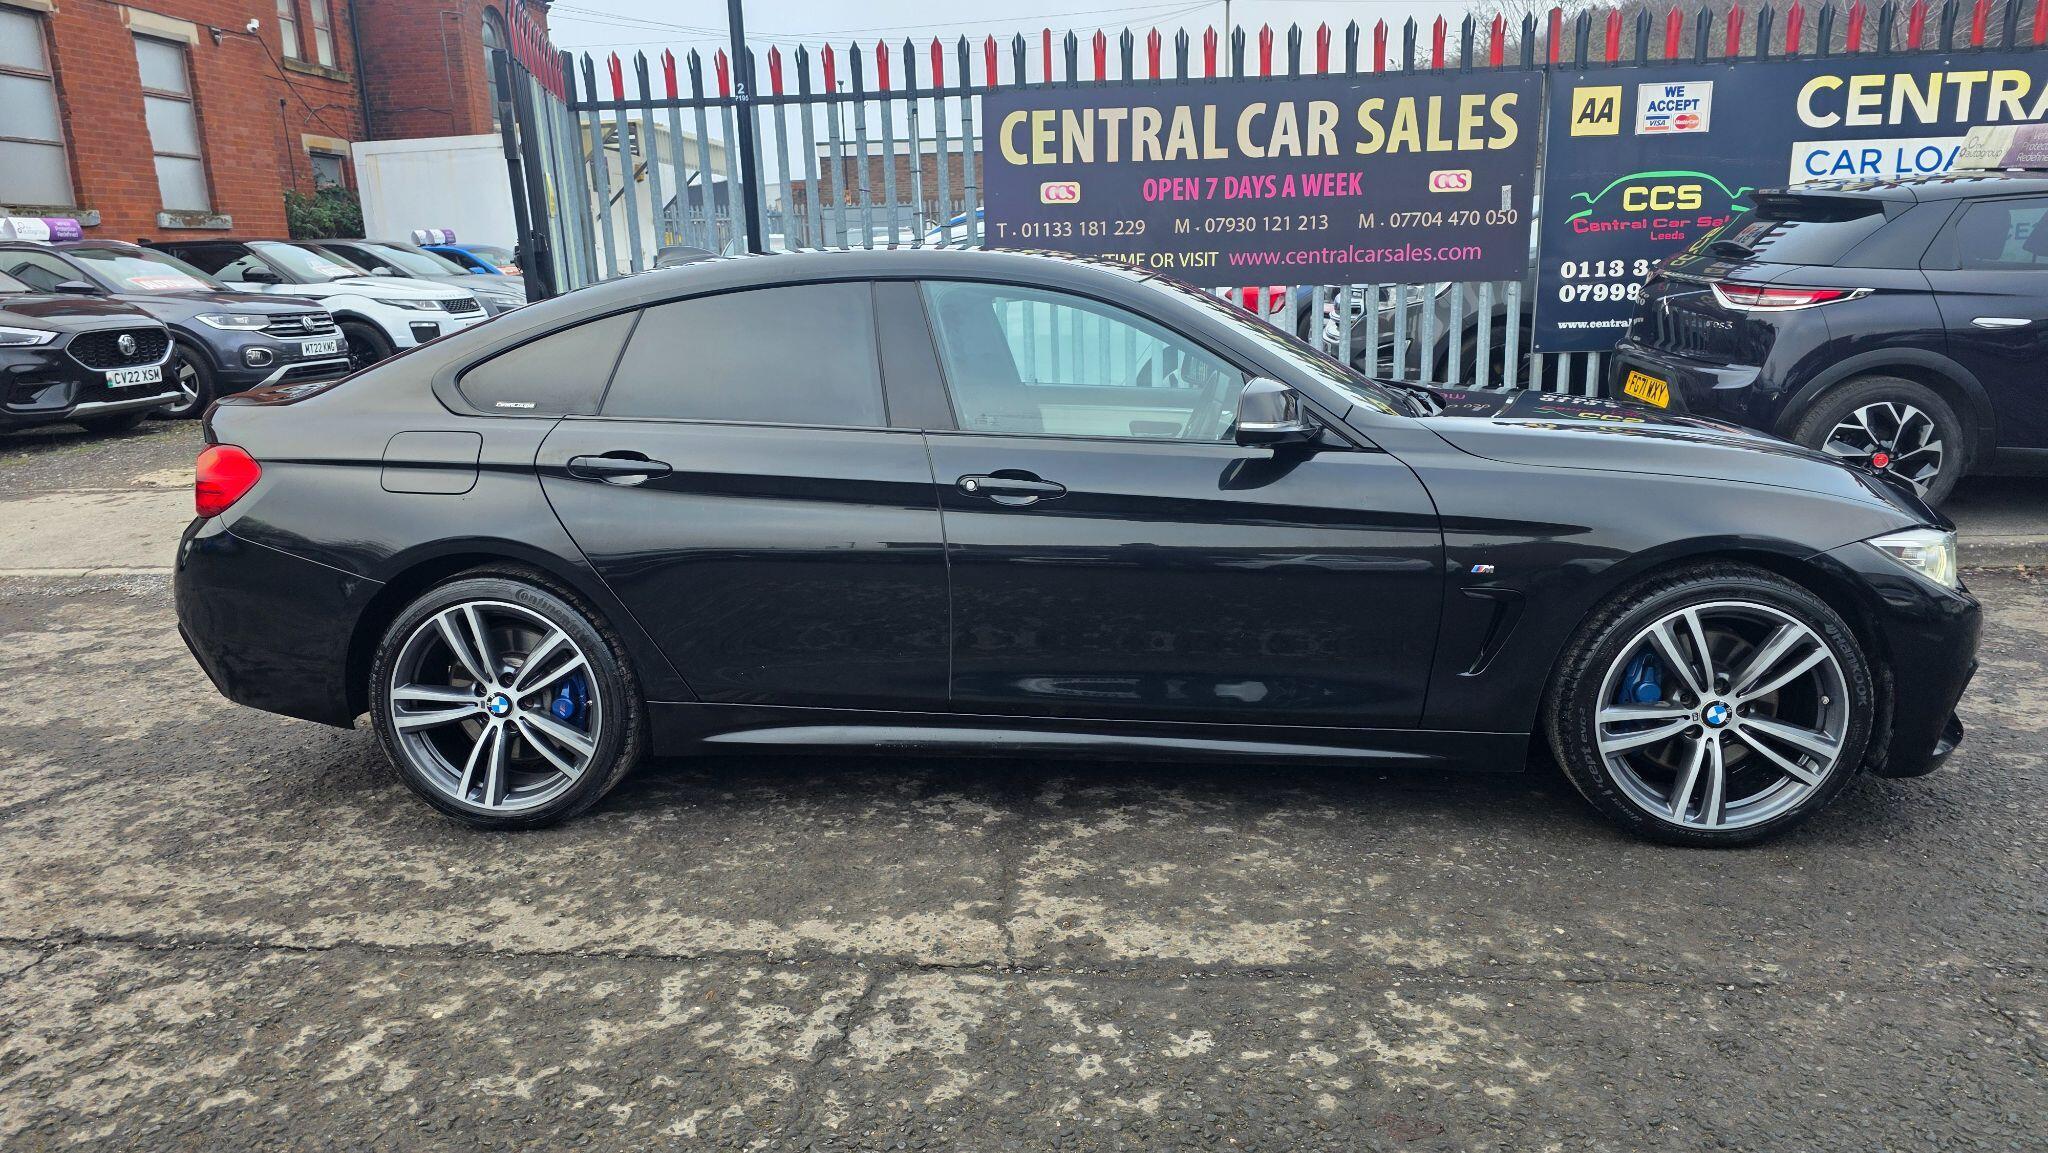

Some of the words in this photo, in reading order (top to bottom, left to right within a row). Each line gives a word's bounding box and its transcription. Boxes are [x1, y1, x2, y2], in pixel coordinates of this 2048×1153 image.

[737, 82, 745, 94] 2
[1664, 86, 1685, 98] WE
[1577, 97, 1614, 124] AA
[1647, 98, 1700, 113] ACCEPT
[1000, 104, 1229, 165] CENTRAL
[1236, 101, 1340, 159] CAR
[1355, 92, 1519, 156] SALES
[1805, 149, 1882, 176] CAR
[1142, 177, 1200, 202] OPEN
[1205, 177, 1219, 200] 7
[1224, 174, 1277, 200] DAYS
[1281, 174, 1296, 198] A
[1301, 172, 1364, 197] WEEK
[1623, 185, 1702, 212] CCS
[1021, 221, 1072, 238] 01133
[1079, 220, 1107, 236] 181
[1113, 219, 1146, 236] 229
[1204, 216, 1257, 234] 07930
[1263, 215, 1290, 231] 121
[1298, 214, 1329, 231] 213
[1389, 211, 1443, 228] 07704
[1447, 210, 1481, 226] 470
[1485, 209, 1518, 225] 050
[1572, 217, 1647, 234] Central
[1653, 218, 1691, 229] Car
[1650, 231, 1685, 241] Leeds
[1150, 252, 1174, 268] OR
[1178, 251, 1220, 267] VISIT
[1228, 243, 1482, 266] www.centralcarsales.com
[1560, 259, 1625, 279] 0113
[114, 371, 140, 385] CV22
[141, 369, 162, 382] XSM
[1647, 381, 1666, 402] WXY
